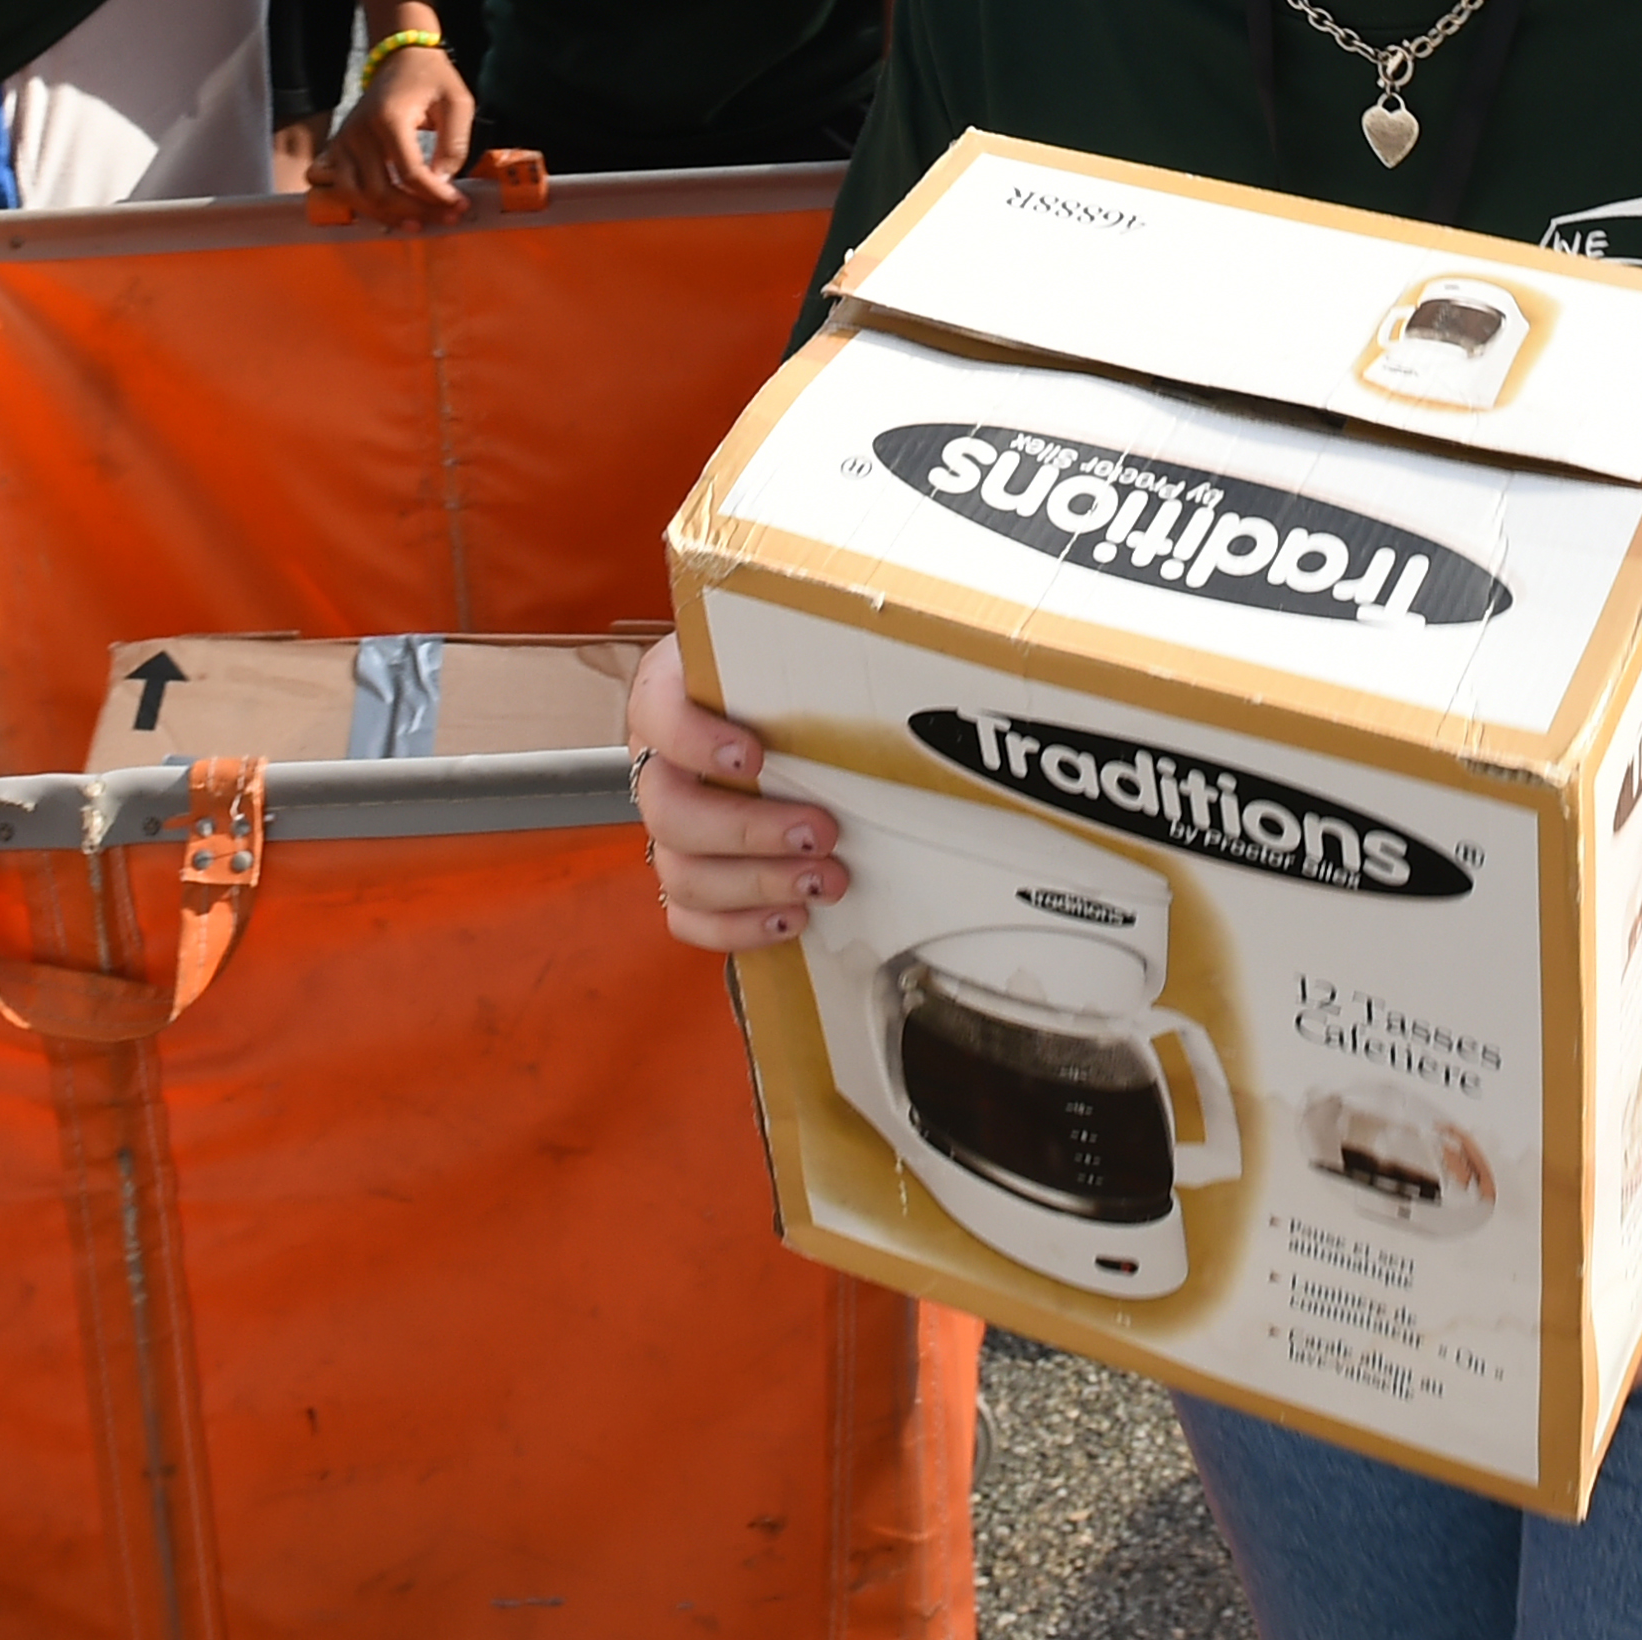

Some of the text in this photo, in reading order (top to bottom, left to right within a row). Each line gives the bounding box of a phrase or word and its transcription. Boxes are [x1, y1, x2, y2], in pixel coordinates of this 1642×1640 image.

[1010, 433, 1078, 469] Silex
[1185, 482, 1224, 508] by
[927, 436, 1430, 628] Traditions
[957, 709, 1413, 886] Traditions
[1295, 971, 1503, 1071] 12 Tasses
